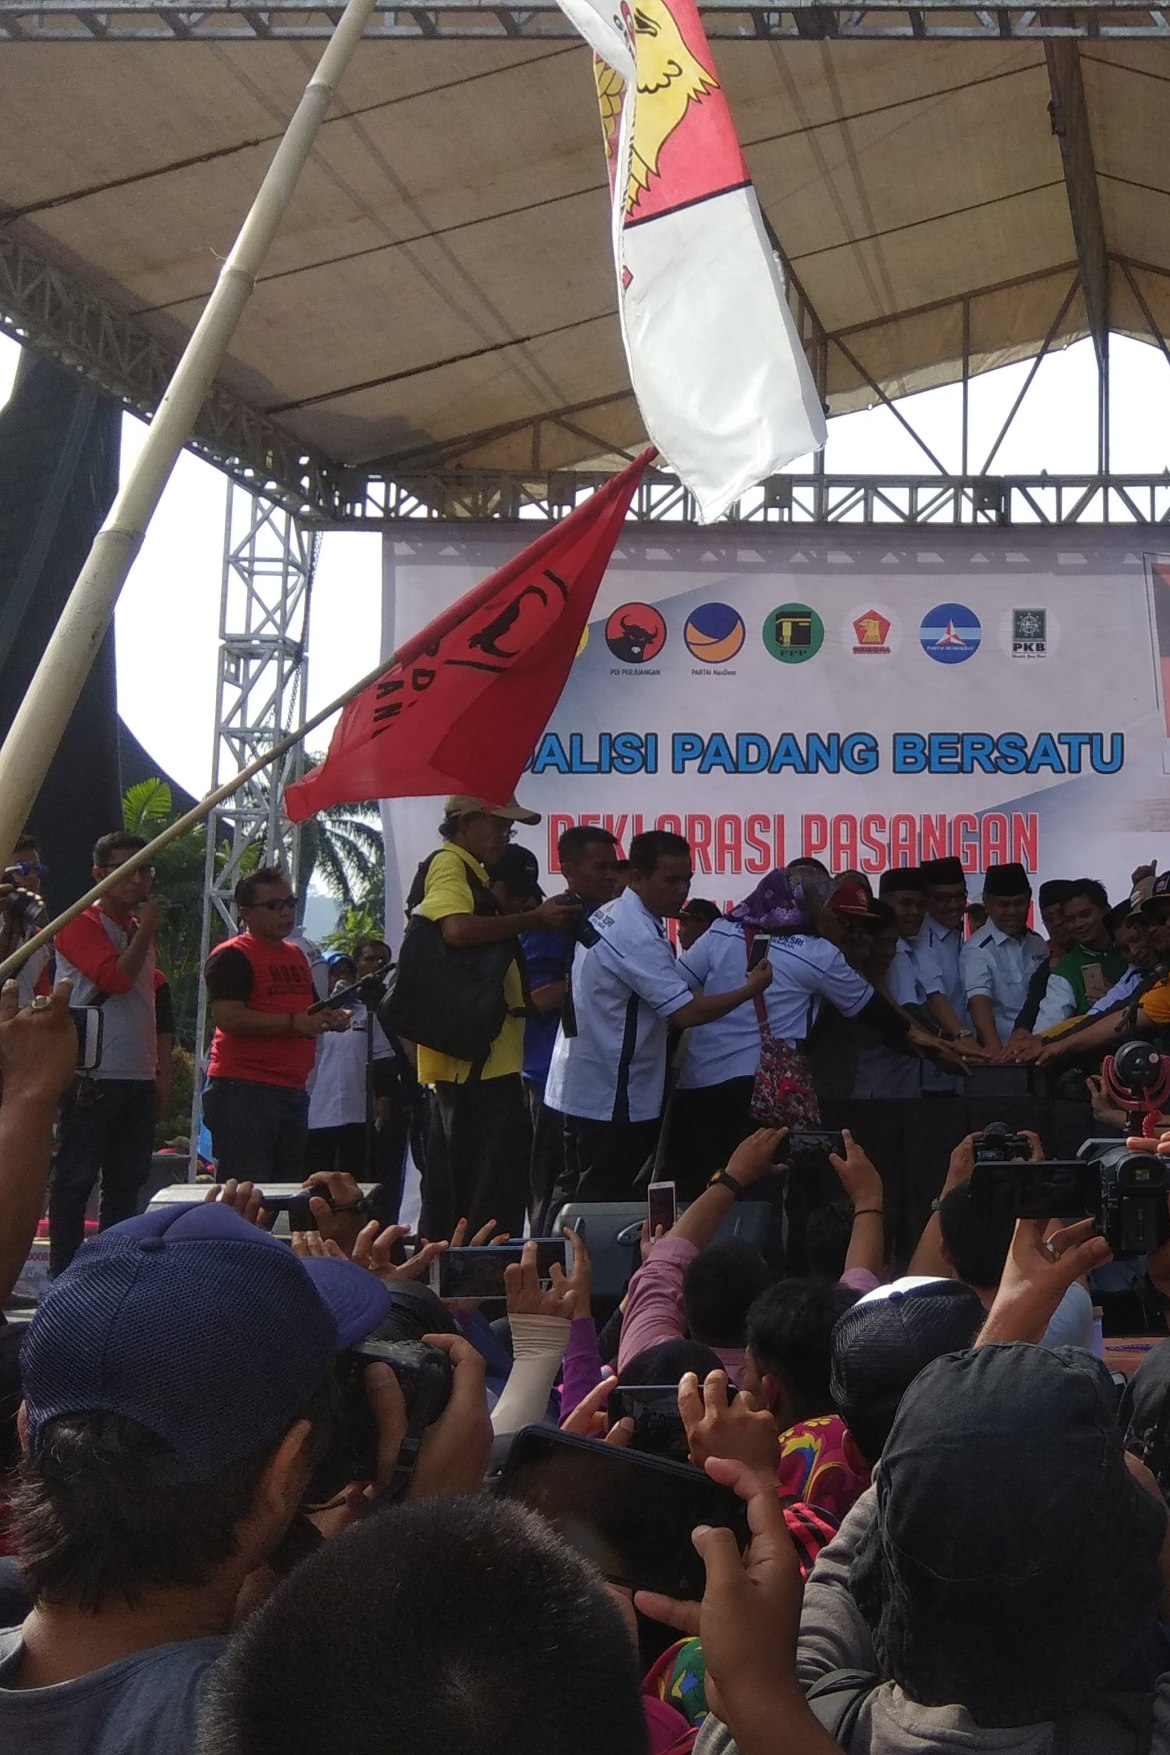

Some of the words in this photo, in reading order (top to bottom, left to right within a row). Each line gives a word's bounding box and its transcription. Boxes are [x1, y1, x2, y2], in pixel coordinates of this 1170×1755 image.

[1012, 642, 1046, 652] PKB
[524, 732, 659, 774] ALISI
[671, 732, 880, 774] PADANG
[891, 732, 1126, 775] BERSATU
[800, 811, 1040, 874] PASANGAN
